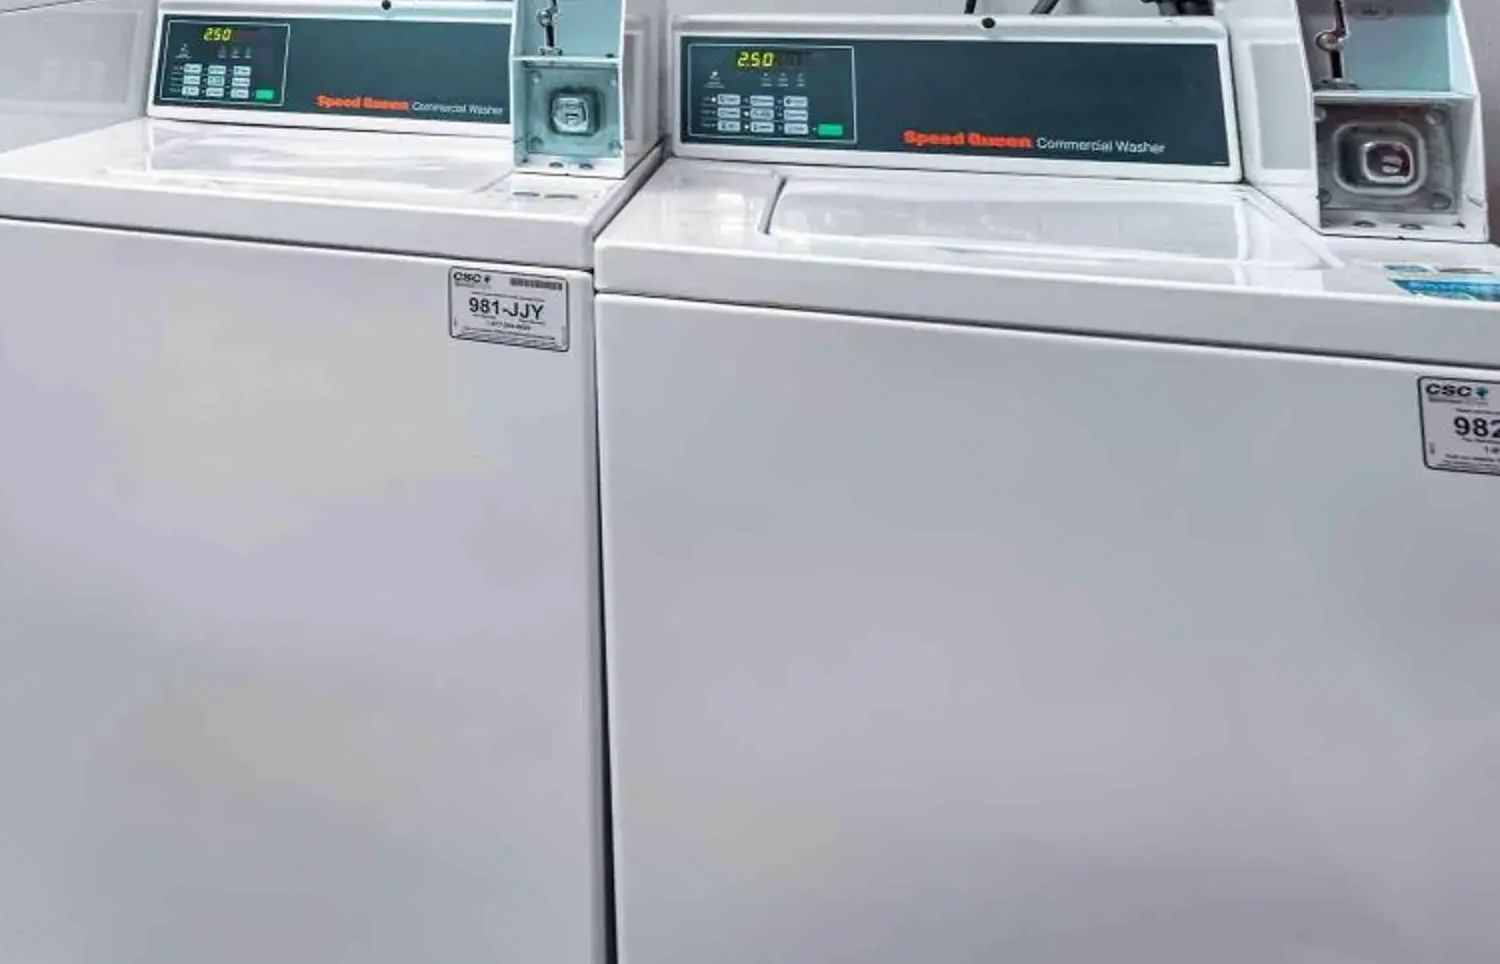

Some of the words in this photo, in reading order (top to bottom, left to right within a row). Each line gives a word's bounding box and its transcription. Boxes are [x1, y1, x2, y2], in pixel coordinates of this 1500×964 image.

[316, 94, 362, 109] Speed
[363, 97, 409, 111] Queen
[411, 100, 467, 114] Commercial
[469, 102, 504, 116] Washer
[903, 129, 965, 146] Speed
[967, 132, 1033, 149] Queen
[1036, 136, 1113, 152] Commercial
[1116, 139, 1165, 154] Washer
[469, 296, 544, 320] 981-JJY
[1425, 383, 1472, 398] CSC
